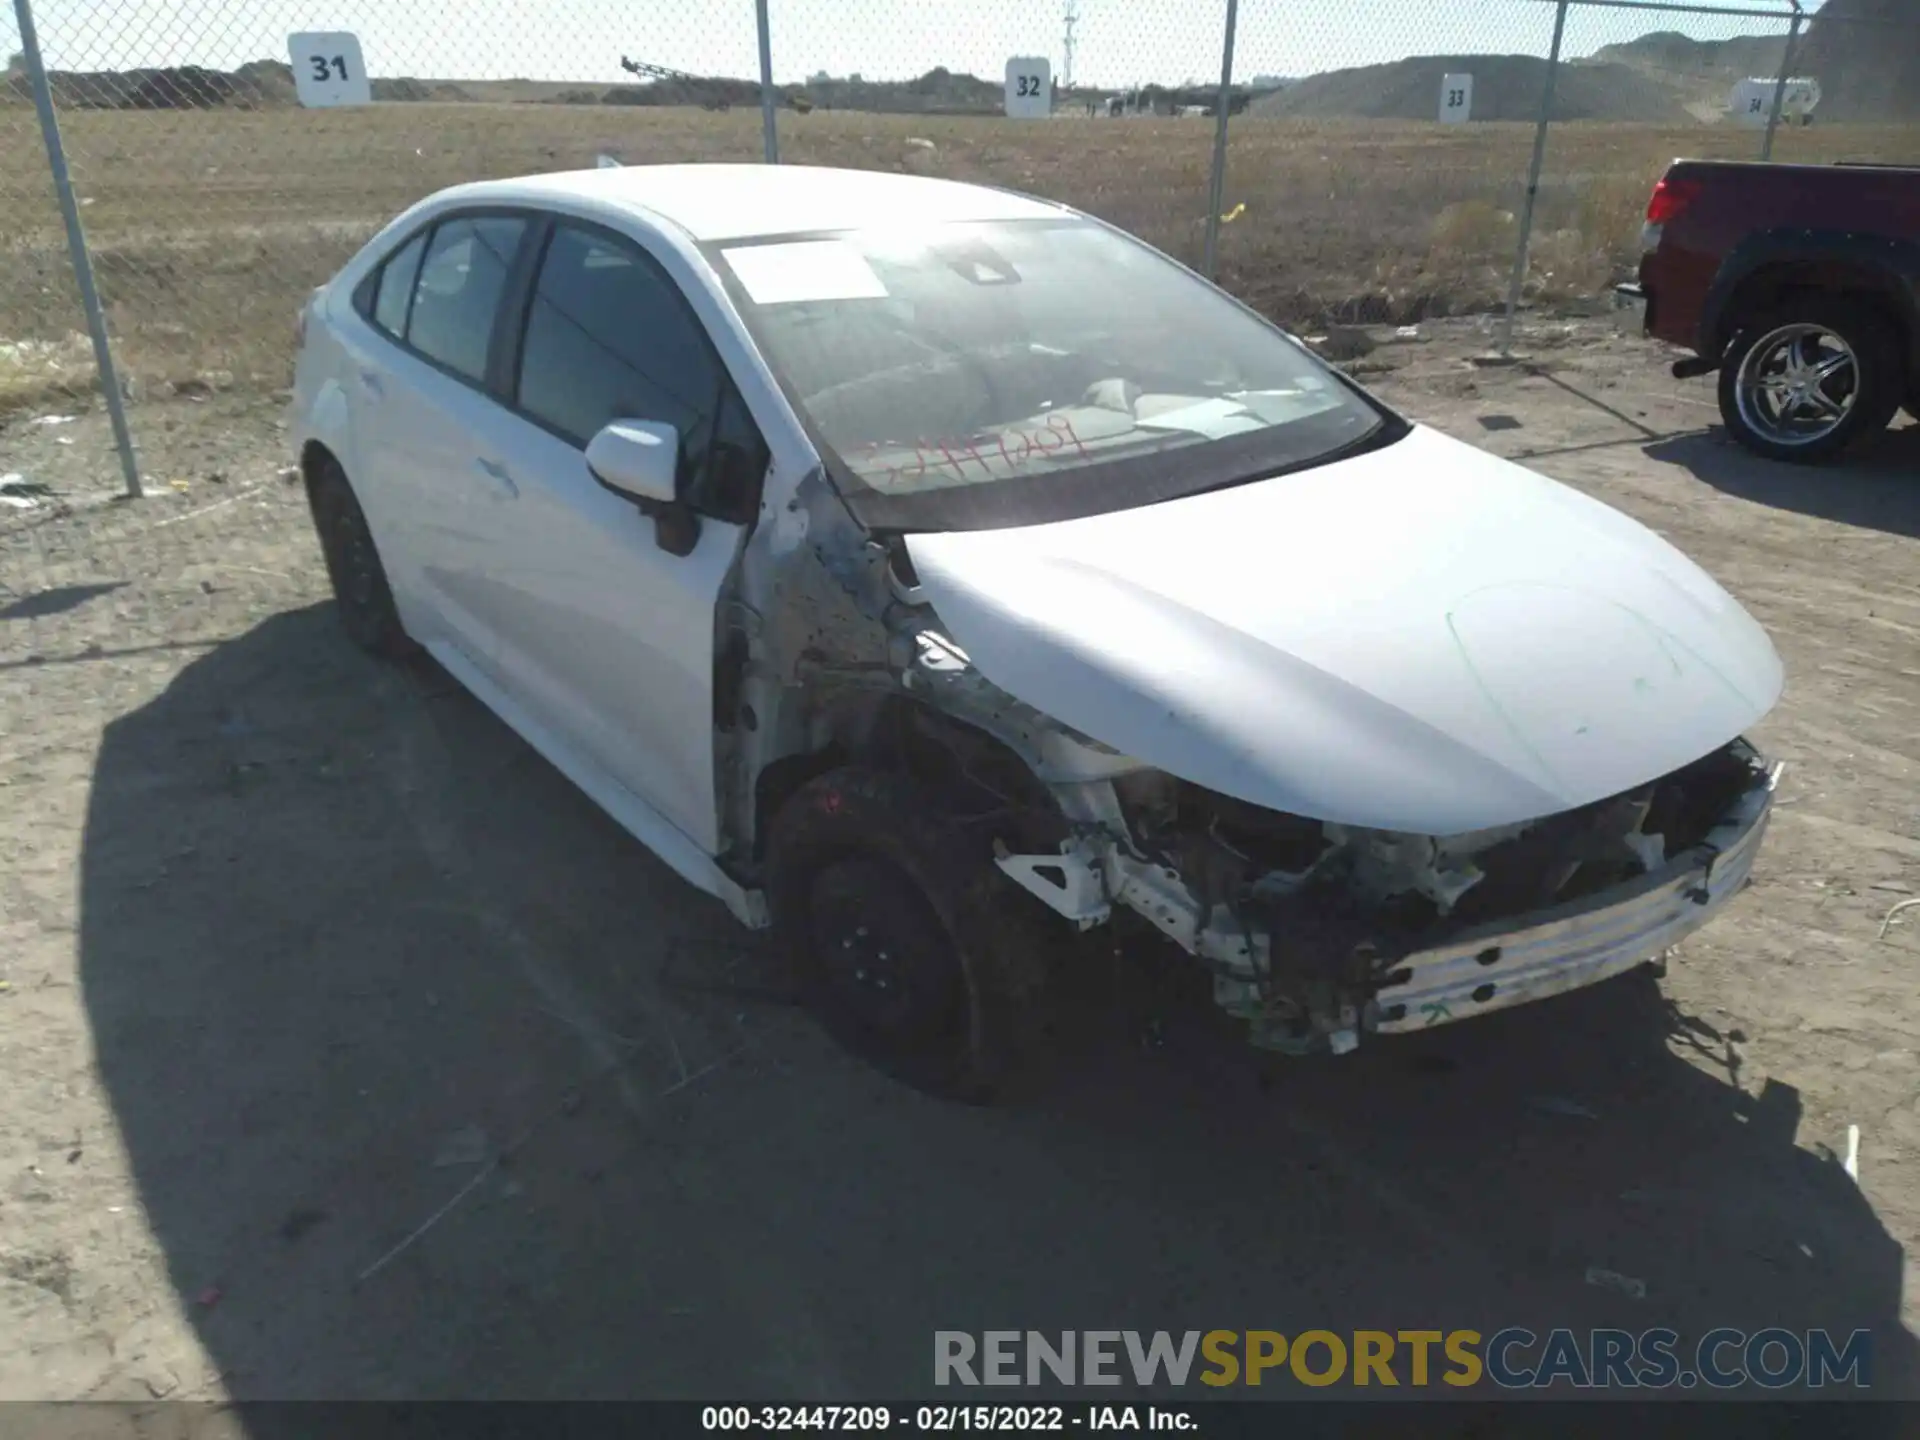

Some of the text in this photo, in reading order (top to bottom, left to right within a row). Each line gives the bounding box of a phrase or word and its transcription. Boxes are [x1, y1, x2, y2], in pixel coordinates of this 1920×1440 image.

[309, 54, 349, 82] 31
[1016, 74, 1041, 98] 32
[1447, 88, 1465, 109] 33
[1749, 97, 1763, 114] 34
